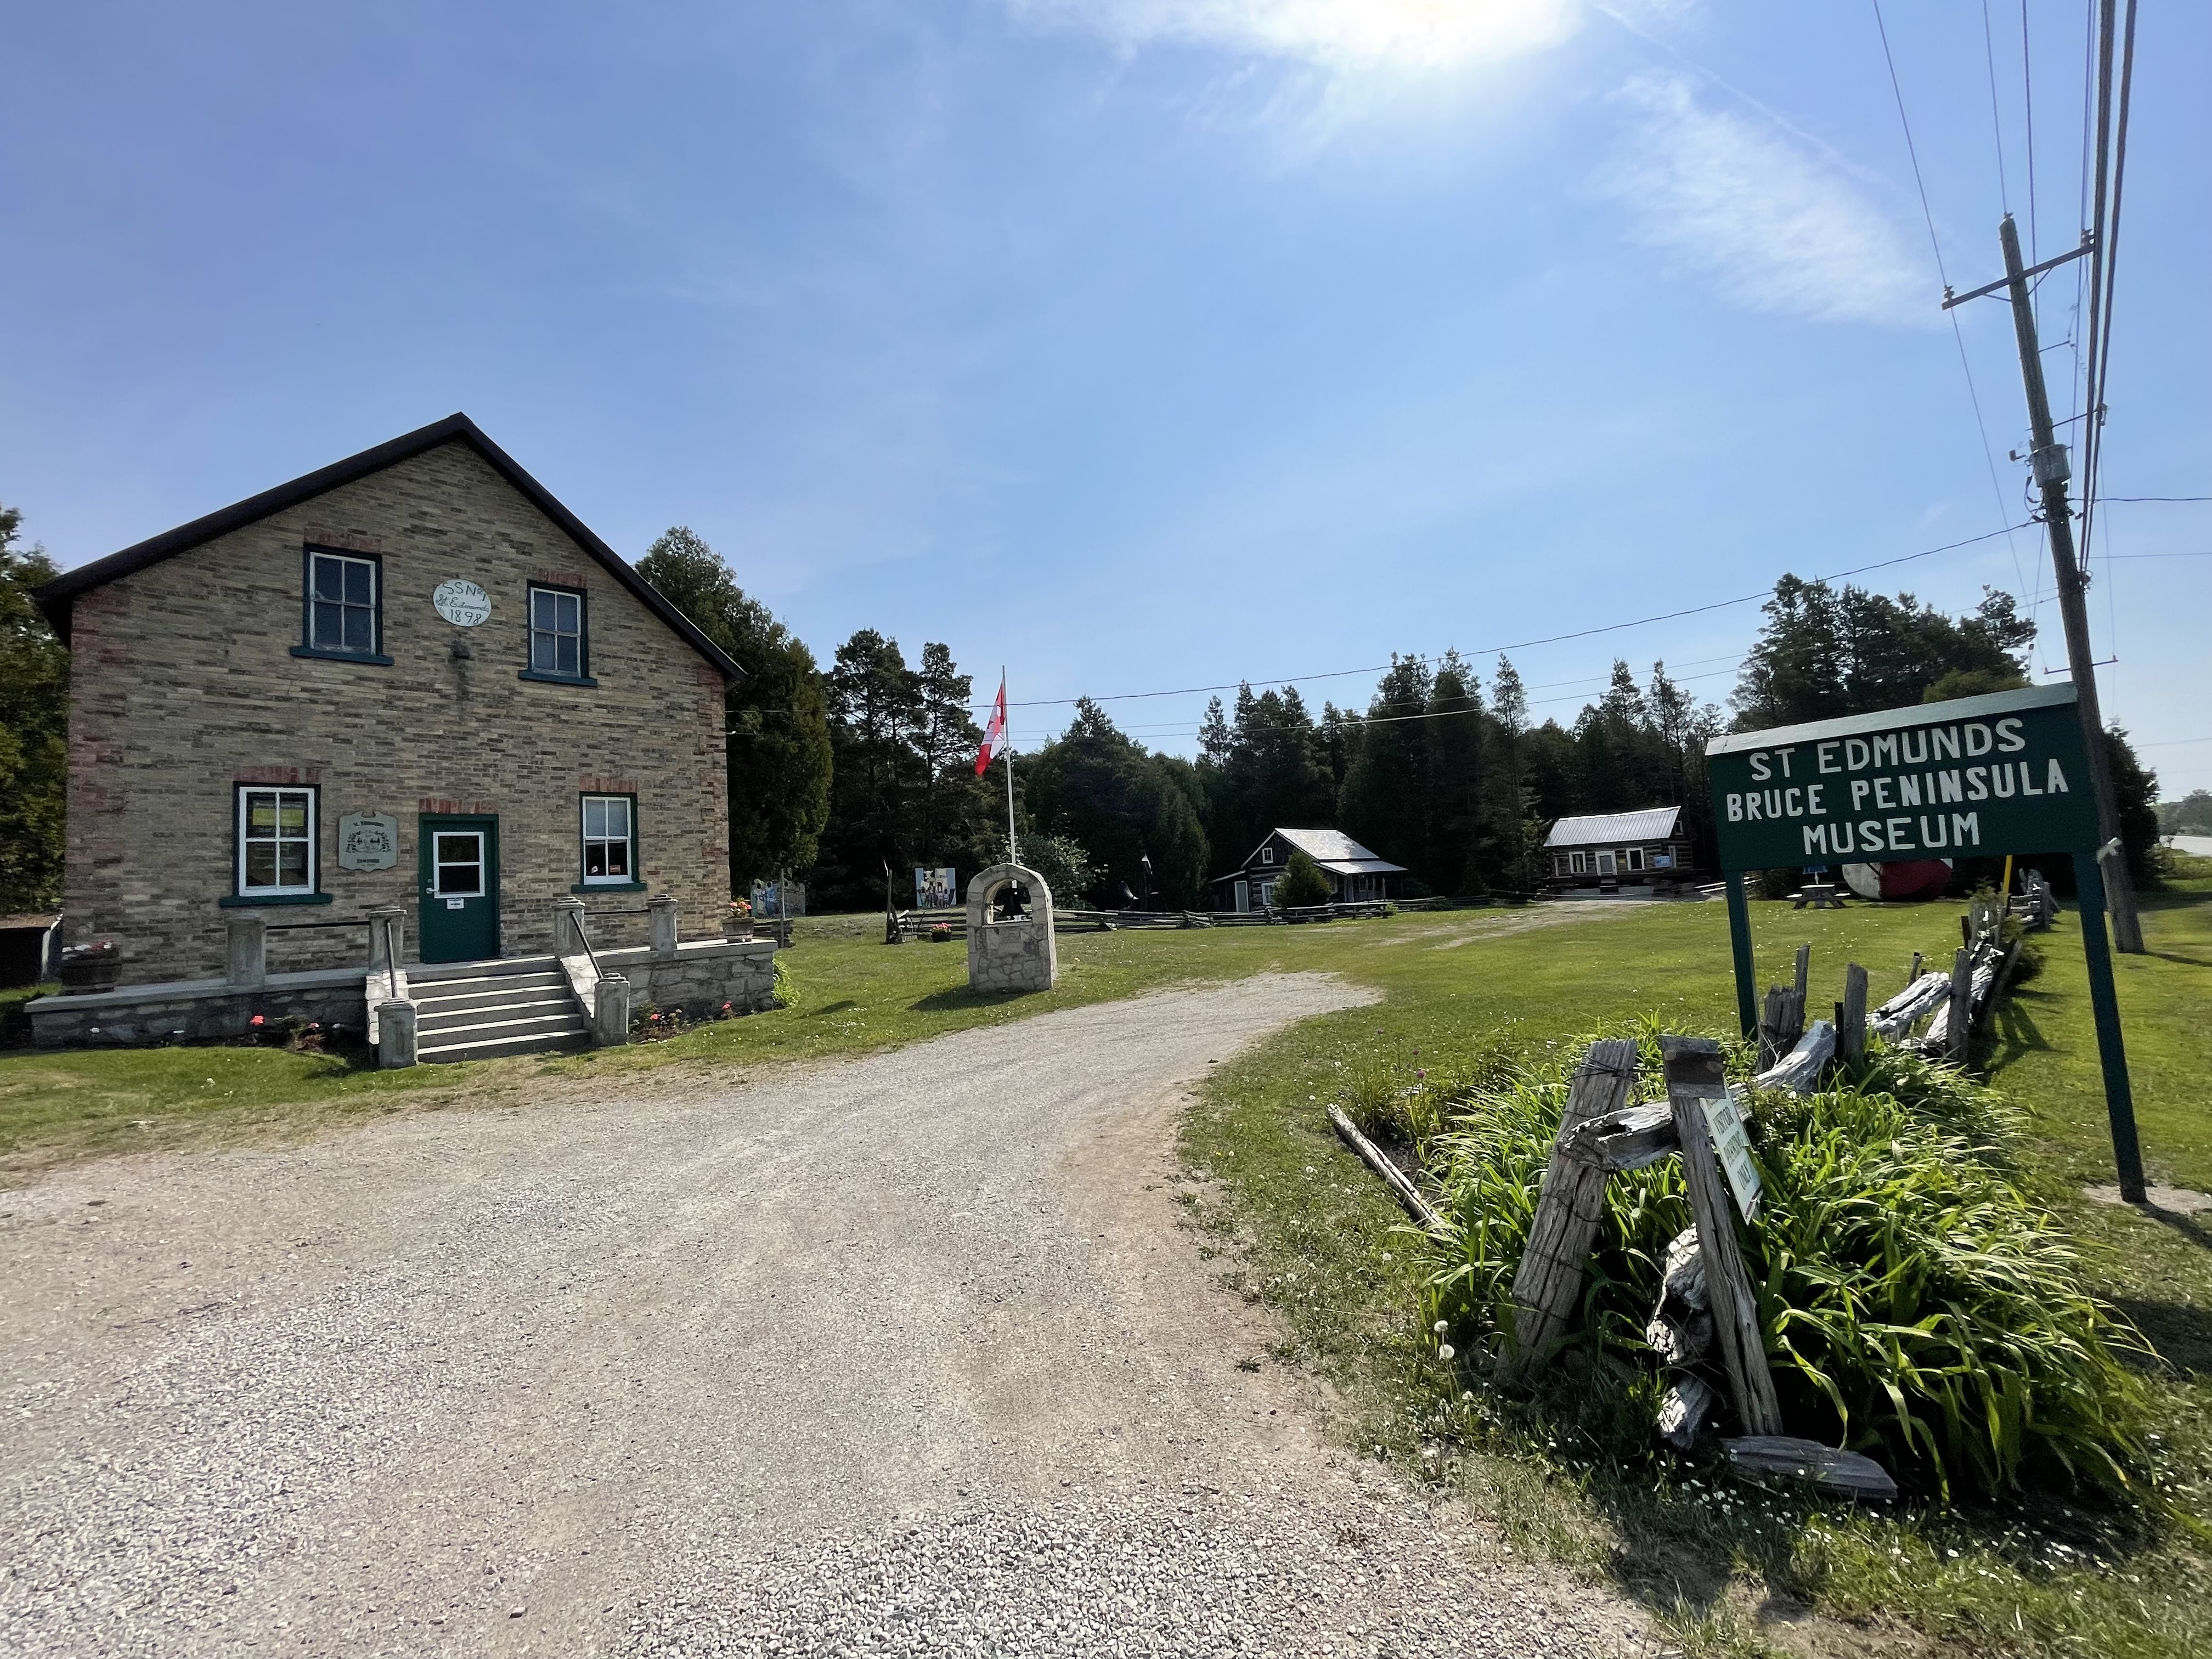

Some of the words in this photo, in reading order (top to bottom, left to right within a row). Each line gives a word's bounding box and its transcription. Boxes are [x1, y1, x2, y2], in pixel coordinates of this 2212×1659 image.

[450, 610, 482, 624] 1898
[1750, 748, 1795, 781] ST
[1817, 718, 2025, 774] EDMUNDS
[1727, 784, 1826, 821] BRUCE
[1851, 759, 2069, 810] PENINSULA
[1803, 812, 1979, 854] MUSEUM
[1713, 1106, 1734, 1135] VISITOR
[1723, 1131, 1744, 1167] PARKING
[1737, 1160, 1752, 1190] ONLY
